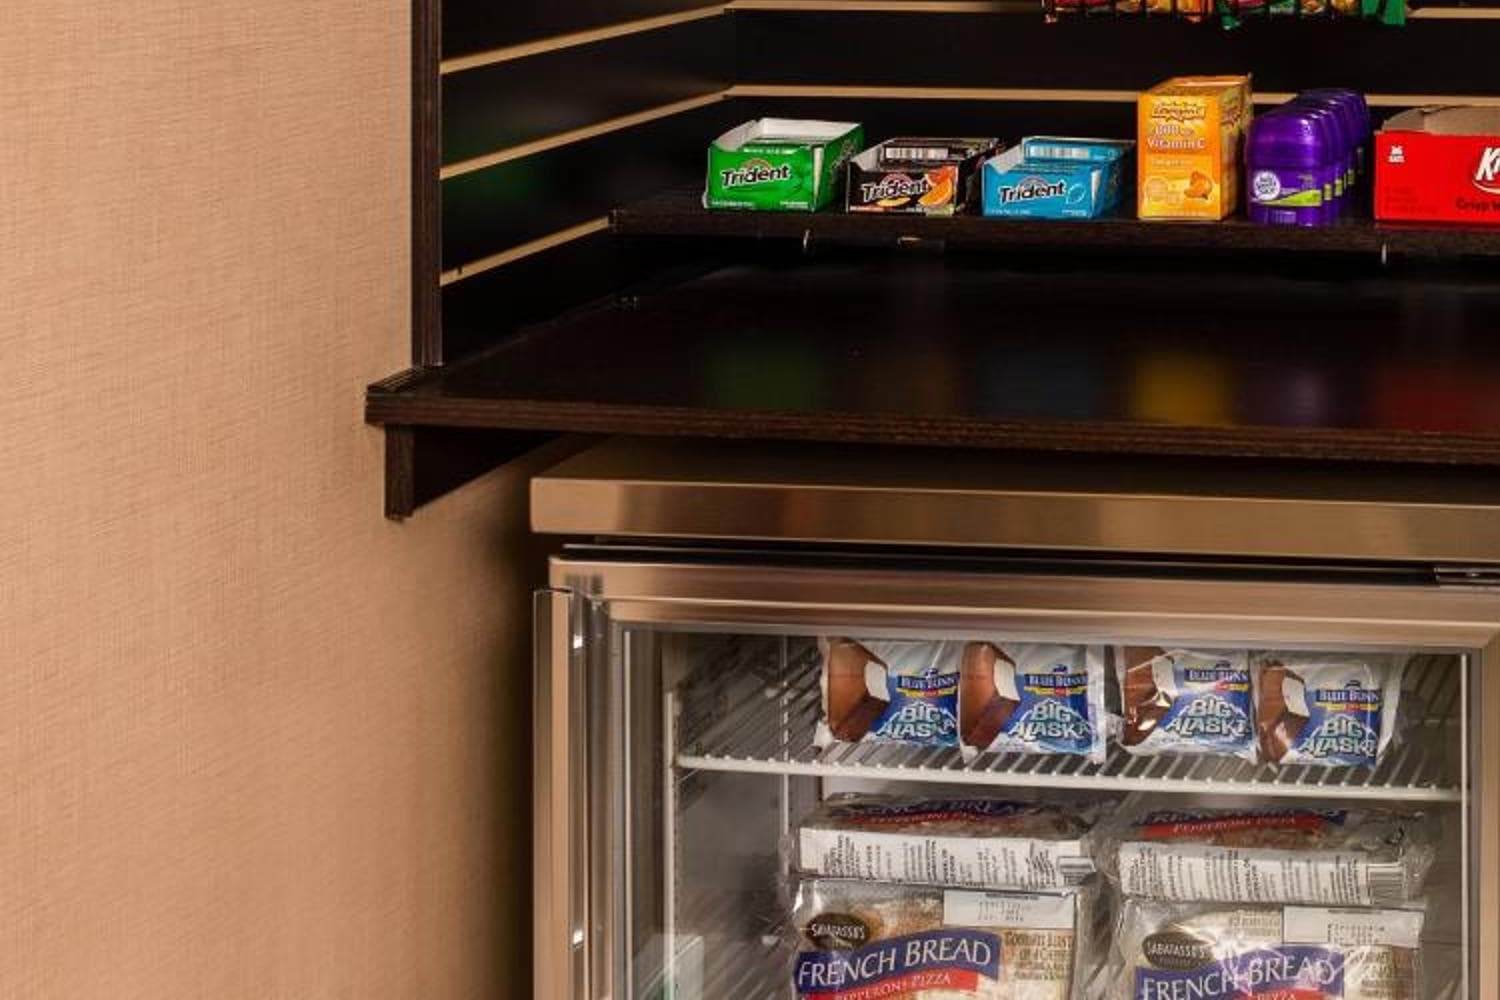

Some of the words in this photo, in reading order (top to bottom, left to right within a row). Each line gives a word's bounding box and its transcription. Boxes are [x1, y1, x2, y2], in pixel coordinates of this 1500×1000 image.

[720, 164, 791, 189] Trident
[861, 178, 929, 202] Trident
[1000, 180, 1066, 204] Trident
[1217, 670, 1248, 682] BUNN
[900, 706, 942, 723] BIG
[1031, 703, 1071, 721] BIG
[1188, 699, 1232, 717] BIG
[1321, 720, 1362, 737] BIG
[798, 947, 896, 987] FRENCH
[905, 937, 991, 967] BREAD
[911, 972, 952, 987] PIZZA
[1141, 966, 1239, 1000] FRENCH
[1250, 956, 1335, 985] BREAD
